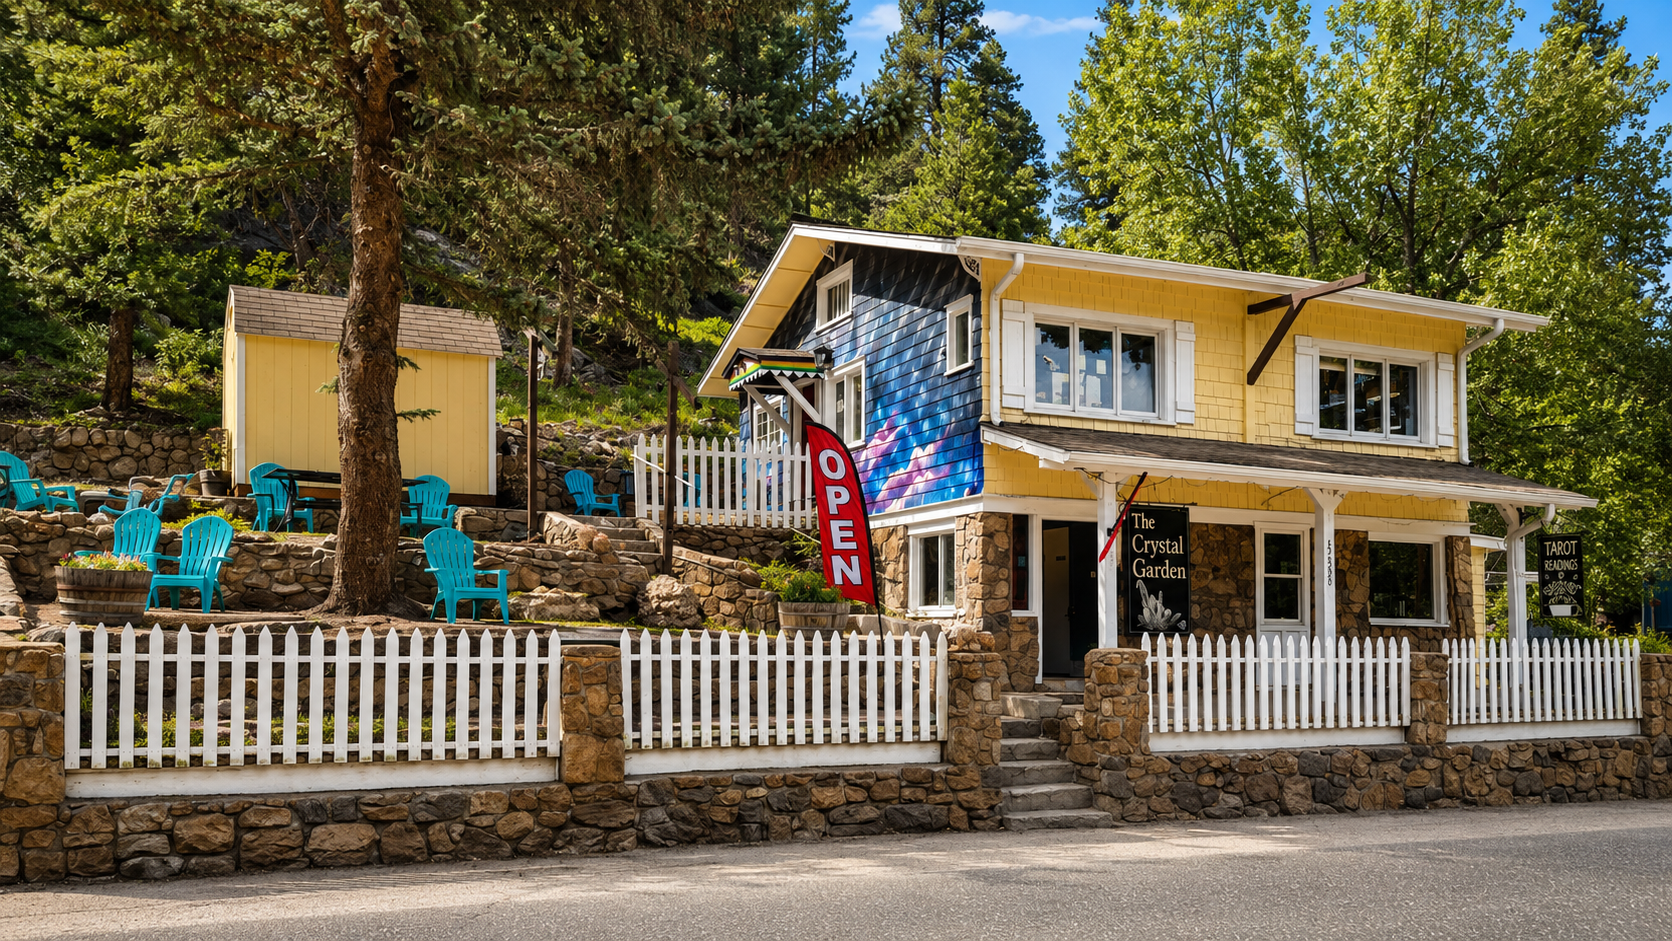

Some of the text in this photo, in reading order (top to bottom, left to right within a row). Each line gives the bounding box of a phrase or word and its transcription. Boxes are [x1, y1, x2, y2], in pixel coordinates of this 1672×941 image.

[818, 448, 863, 586] OPEN
[1131, 512, 1156, 529] The
[1132, 533, 1185, 559] Crystal
[1543, 540, 1578, 556] TAROT
[1132, 558, 1187, 579] Garden
